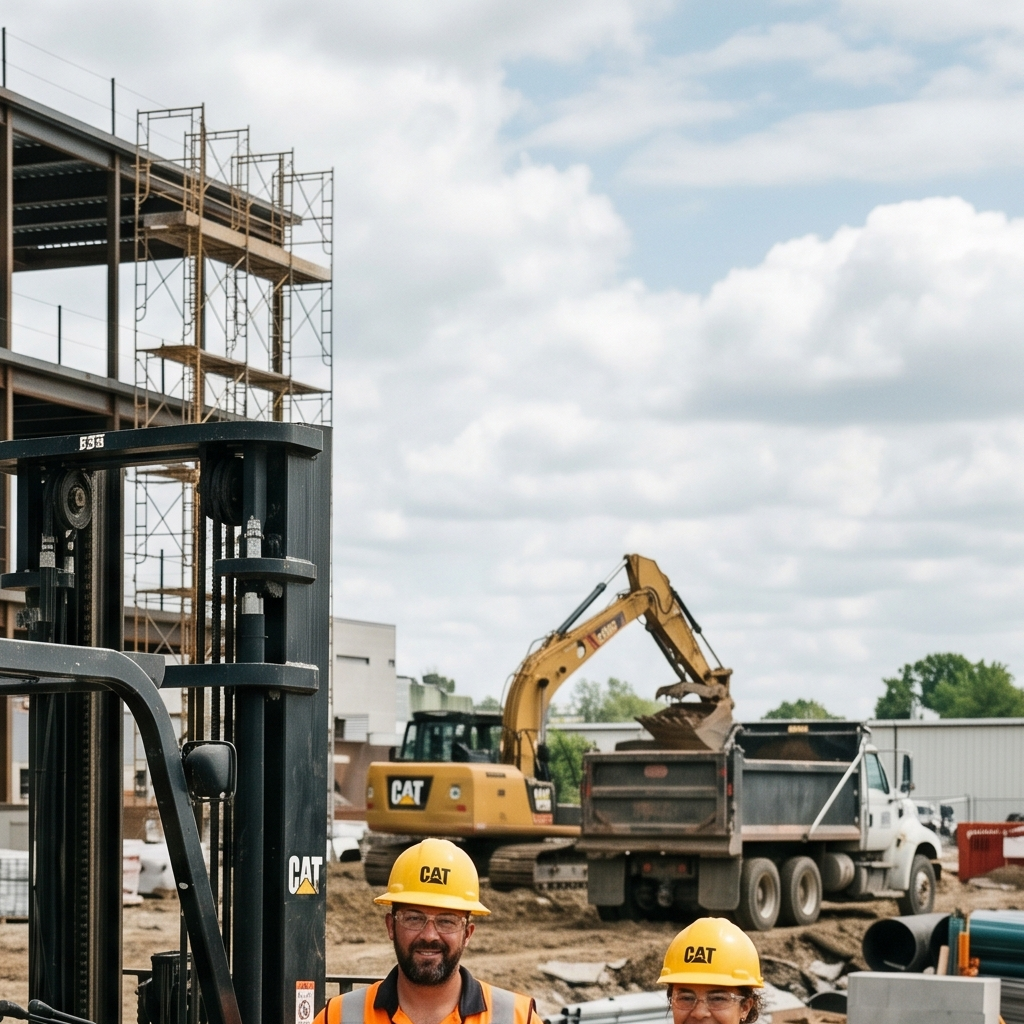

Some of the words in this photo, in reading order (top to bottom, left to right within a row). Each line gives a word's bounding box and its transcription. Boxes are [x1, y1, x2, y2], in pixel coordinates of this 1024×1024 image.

[391, 780, 424, 805] CAT
[288, 855, 323, 895] CAT
[420, 866, 451, 885] CAT
[684, 946, 716, 964] CAT
